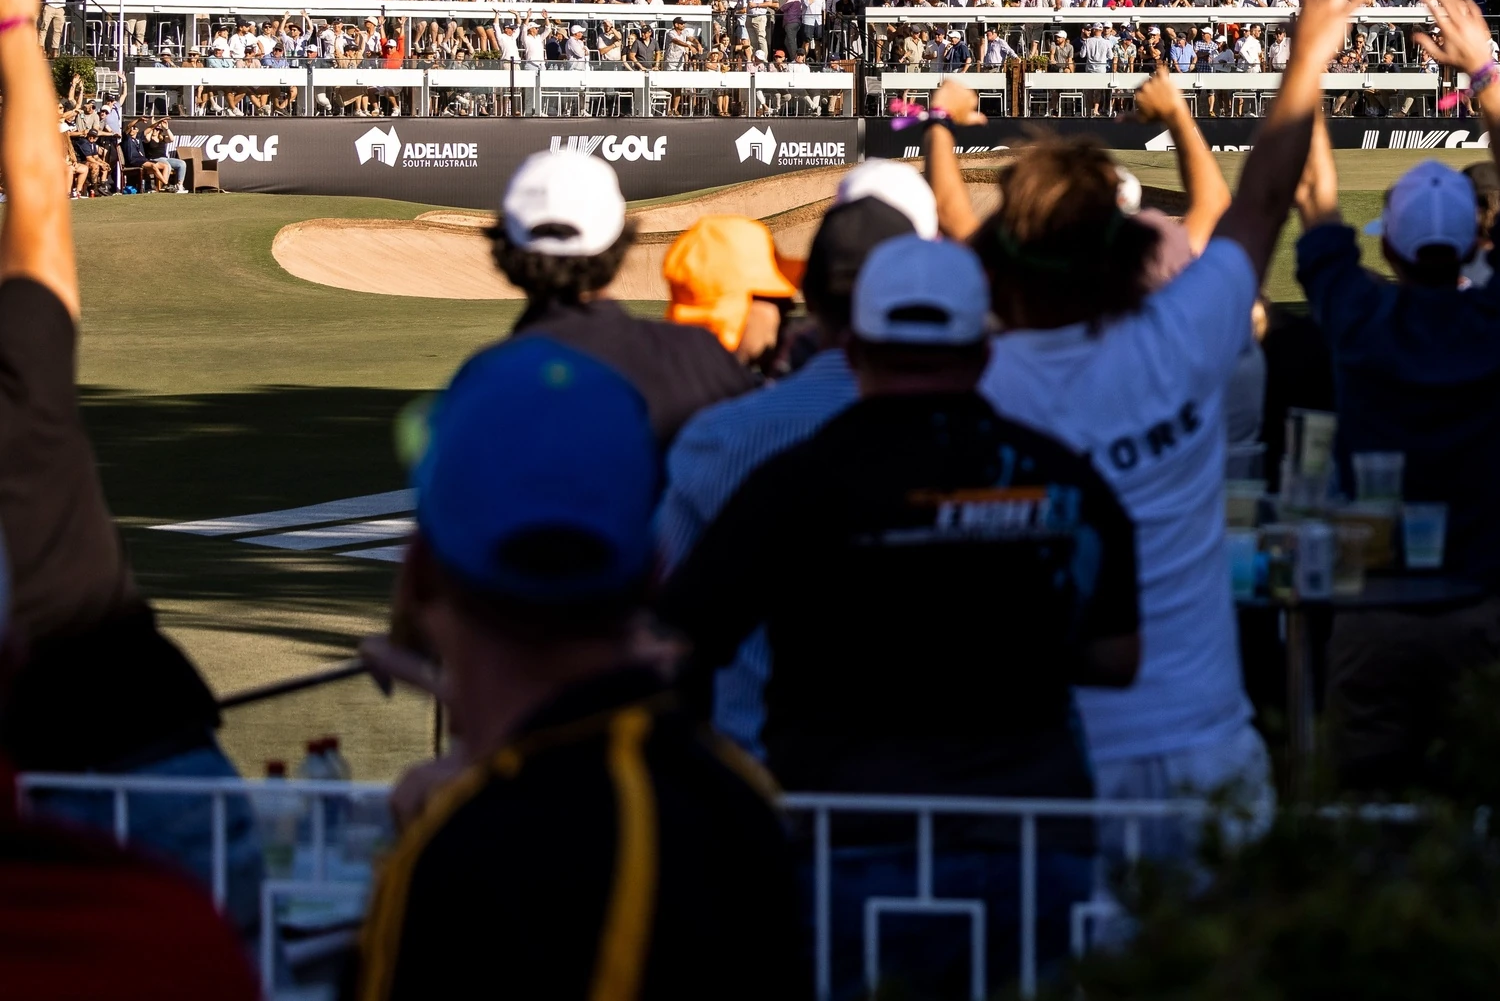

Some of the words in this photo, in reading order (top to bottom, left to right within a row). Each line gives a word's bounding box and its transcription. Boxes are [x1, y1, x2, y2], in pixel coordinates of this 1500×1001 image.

[403, 143, 477, 158] ADELAIDE
[778, 142, 845, 157] ADELAIDE
[403, 159, 430, 167] SOUTH
[434, 159, 478, 167] AUSTRALIA
[806, 157, 845, 165] AUSTRALIA
